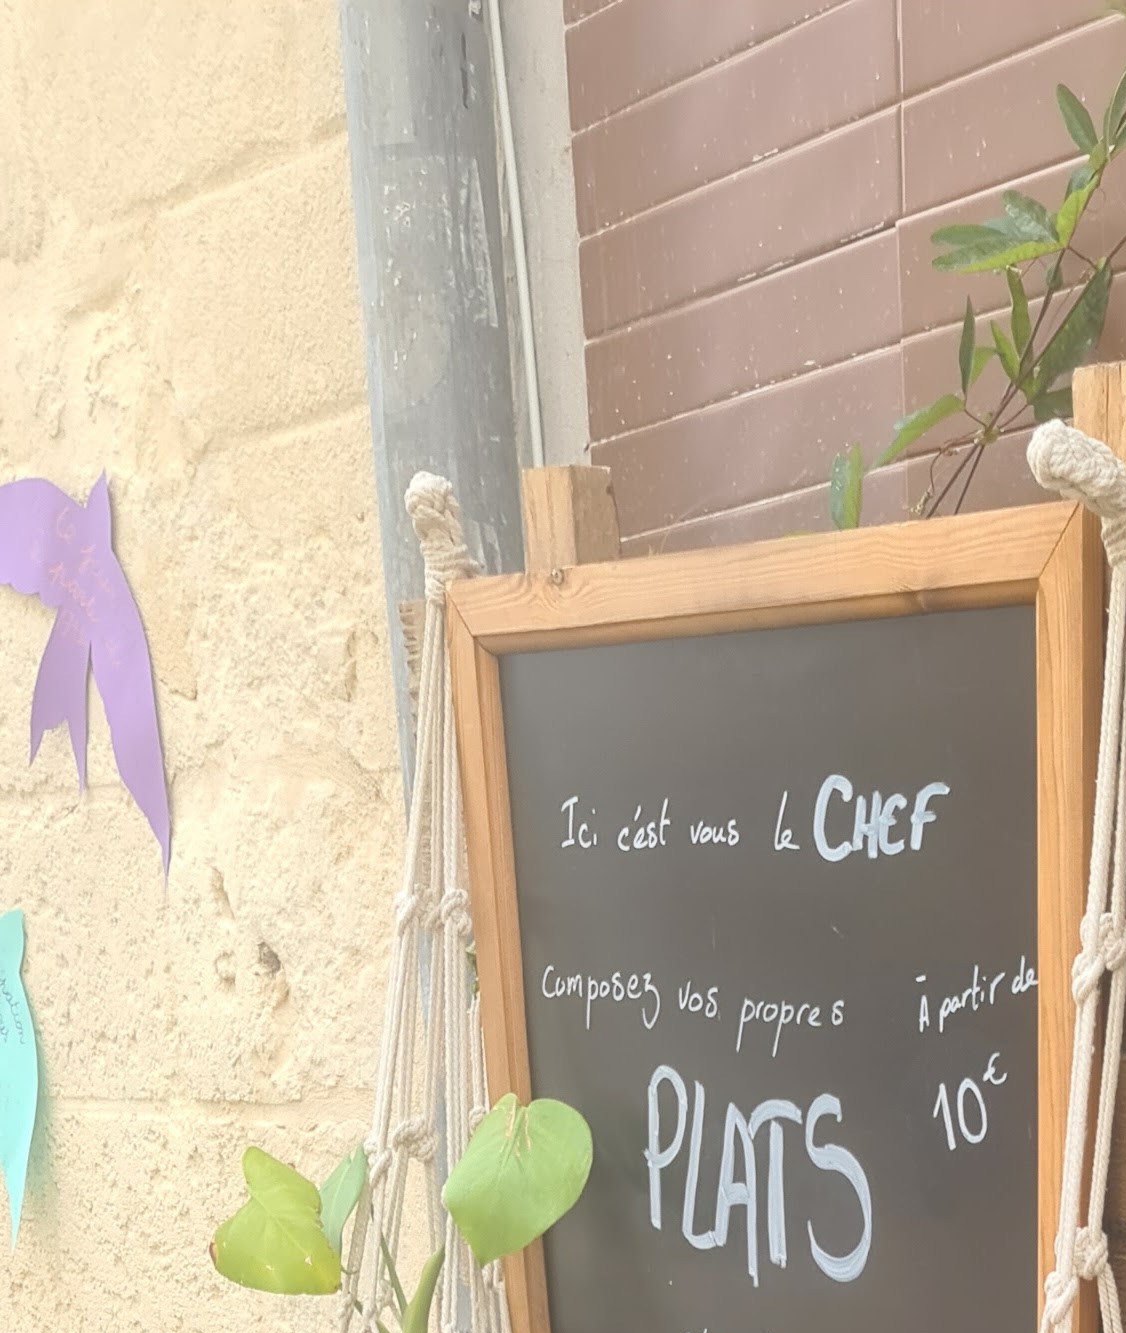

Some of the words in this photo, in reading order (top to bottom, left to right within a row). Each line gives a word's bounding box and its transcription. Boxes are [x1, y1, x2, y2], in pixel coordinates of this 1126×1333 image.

[561, 796, 598, 849] Ici
[690, 819, 740, 846] vous
[773, 791, 800, 851] le
[813, 774, 951, 863] CHEF
[541, 965, 661, 1029] Composez
[678, 981, 719, 1020] vos
[735, 998, 845, 1057] propres
[939, 964, 1006, 1034] partir
[1011, 955, 1039, 995] de
[644, 1064, 872, 1288] PLATS
